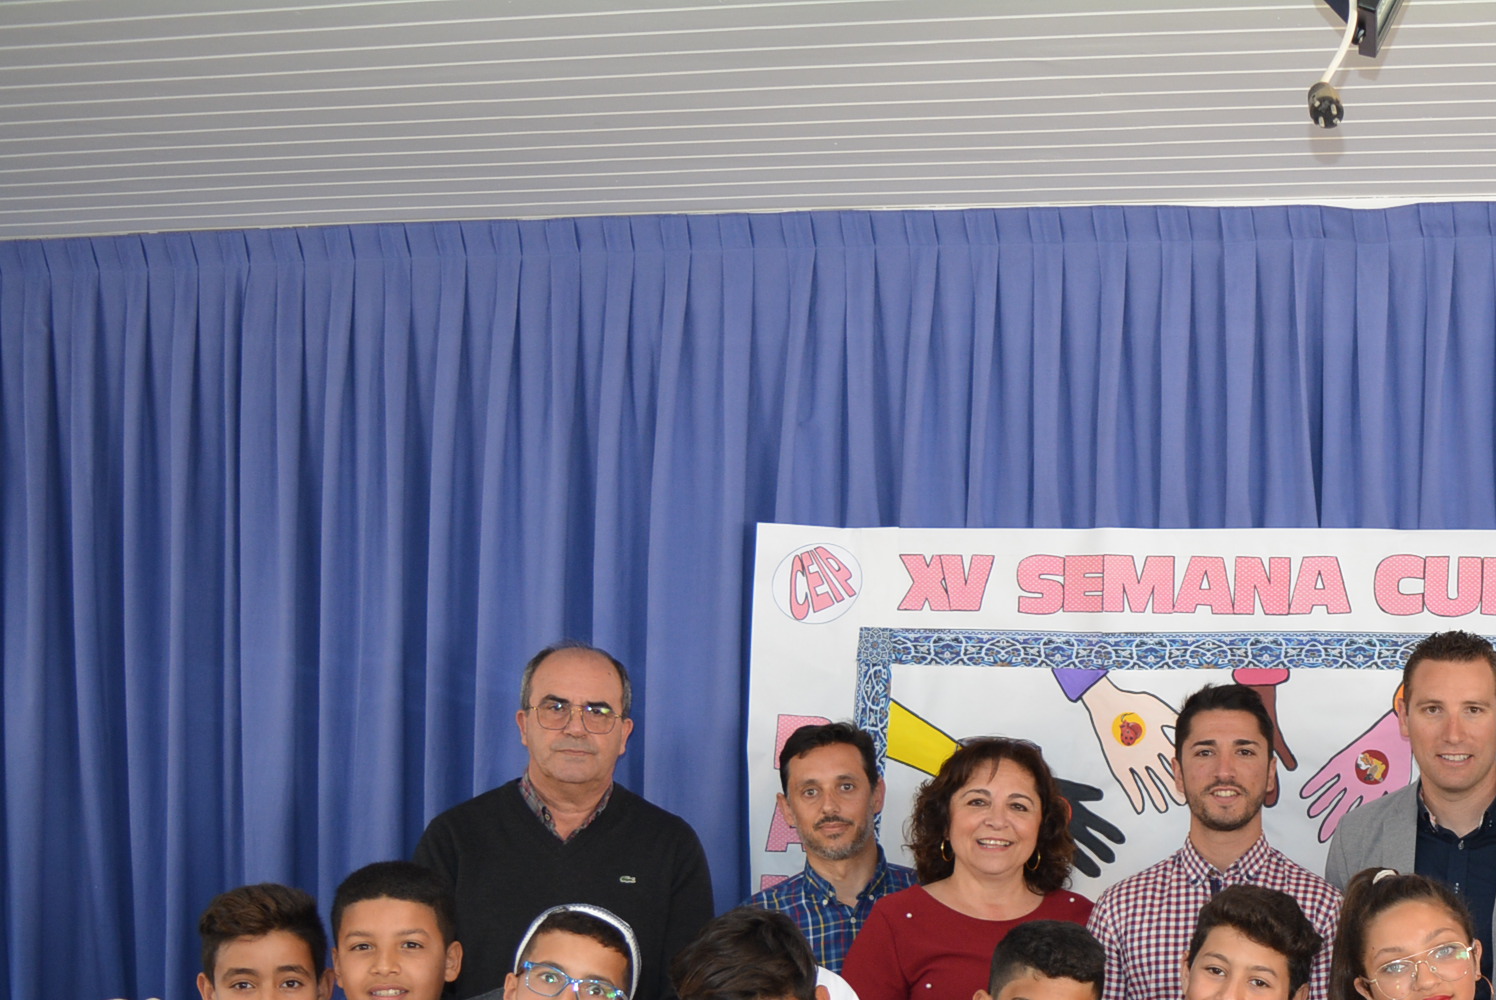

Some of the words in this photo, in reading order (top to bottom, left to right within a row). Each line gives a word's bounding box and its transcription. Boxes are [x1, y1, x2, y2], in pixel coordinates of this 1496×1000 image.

[789, 546, 857, 621] CEIP
[897, 553, 995, 612] XV
[1016, 554, 1352, 616] SEMANA
